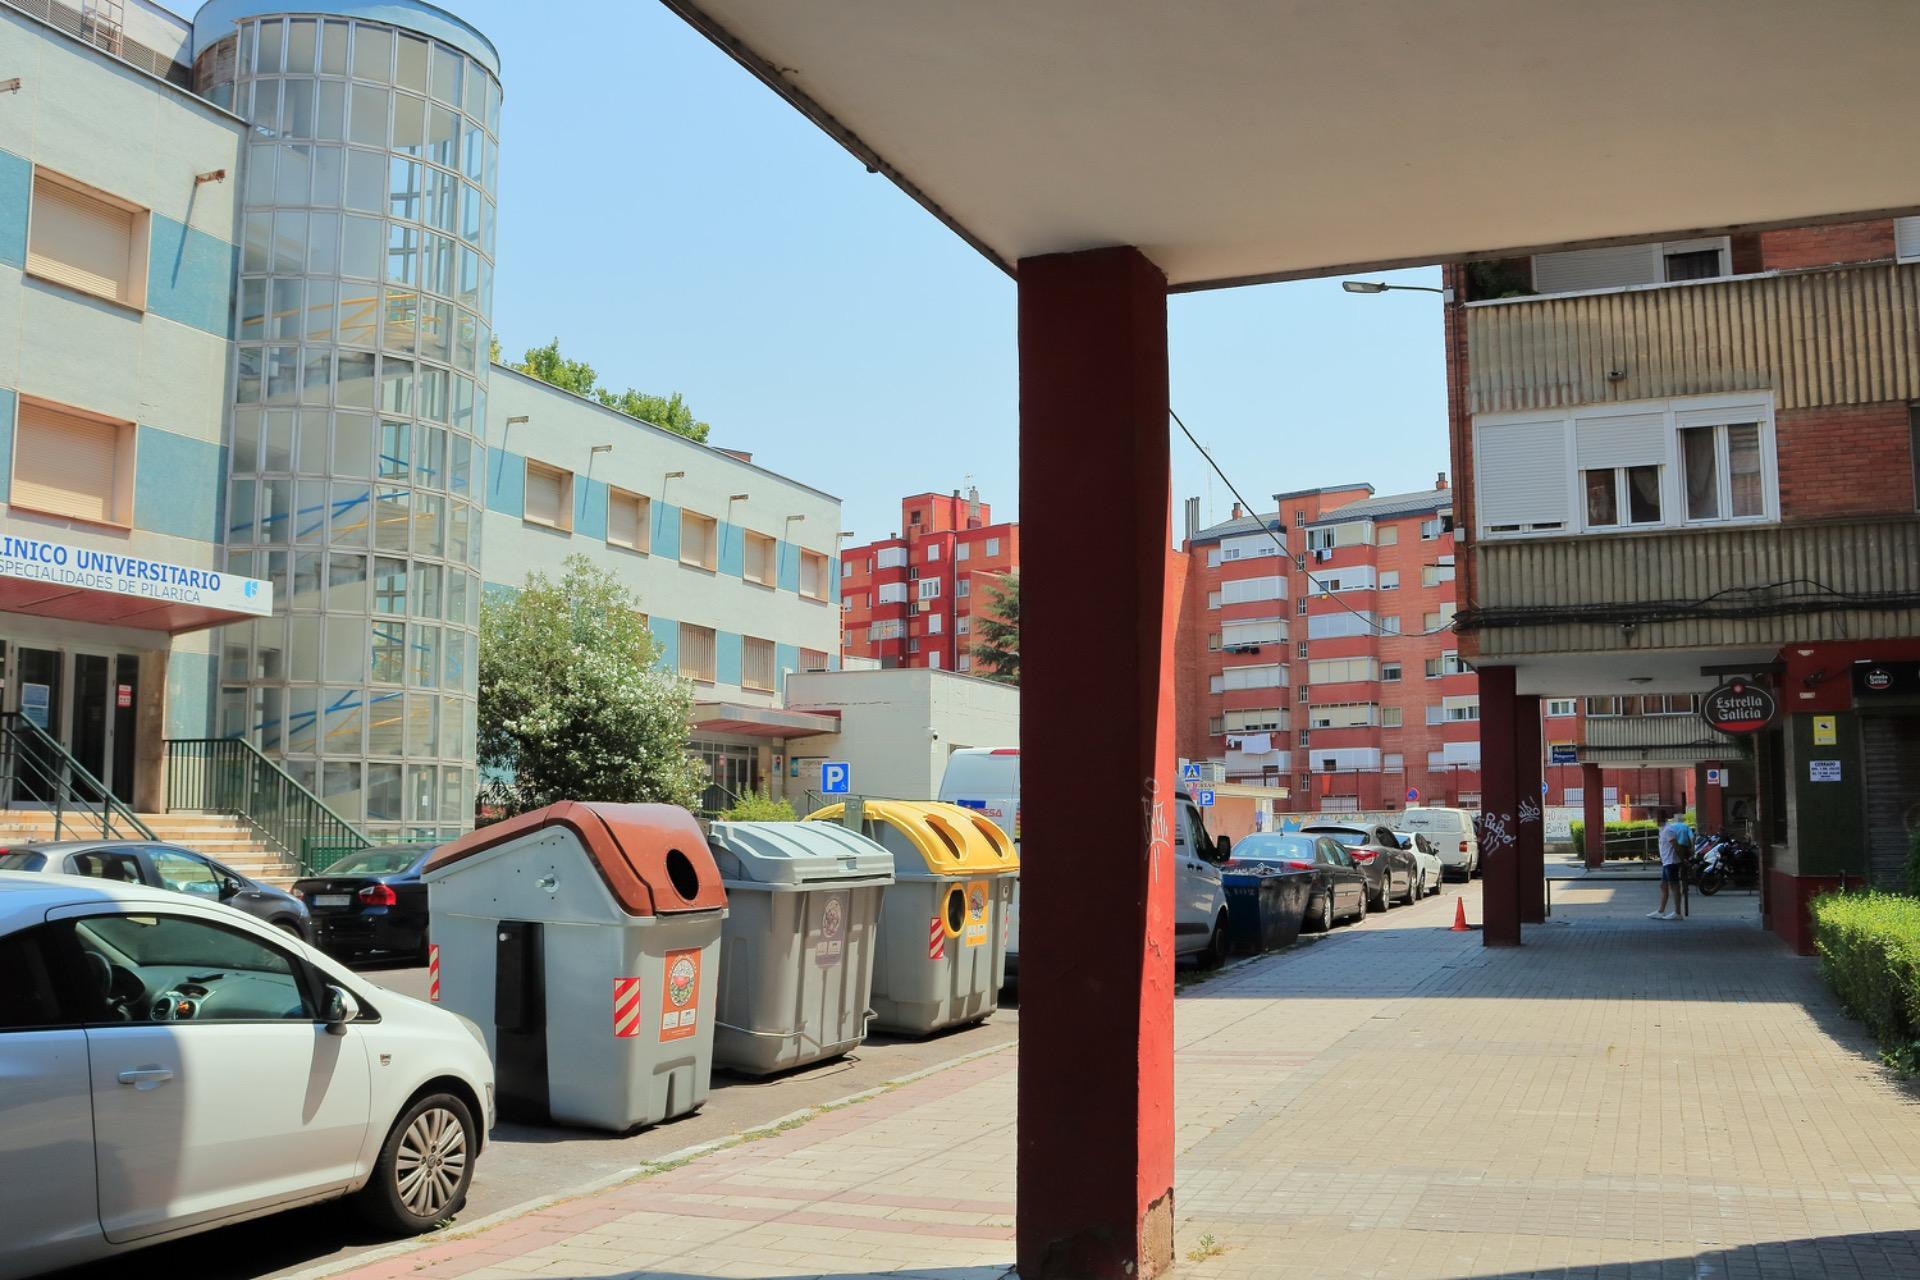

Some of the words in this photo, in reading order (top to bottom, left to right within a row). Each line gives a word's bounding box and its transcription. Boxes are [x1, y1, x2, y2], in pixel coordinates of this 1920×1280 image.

[0, 537, 67, 565] INICO
[77, 550, 221, 591] UNIVERSITARIO
[118, 579, 136, 594] DE
[141, 582, 201, 604] PILARICA
[1716, 696, 1763, 709] Estrella
[1718, 707, 1762, 721] Galicia
[827, 766, 844, 790] P
[1202, 793, 1211, 804] P
